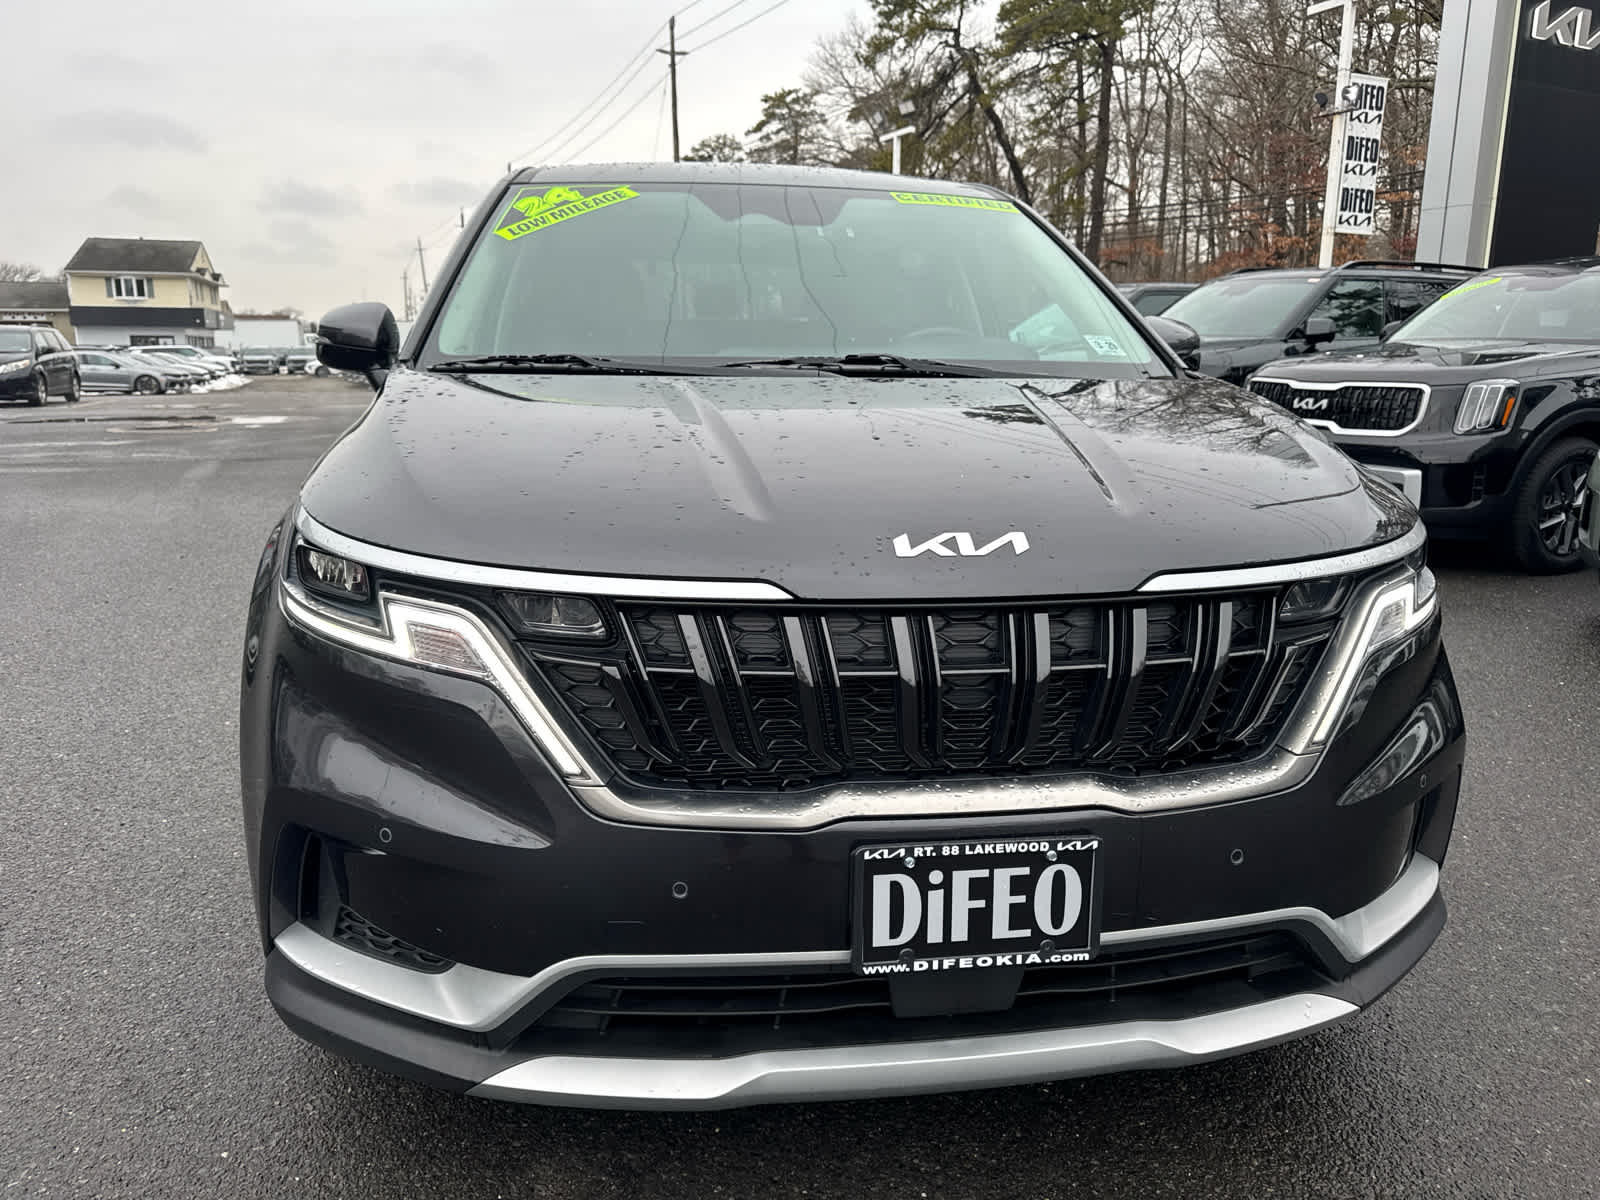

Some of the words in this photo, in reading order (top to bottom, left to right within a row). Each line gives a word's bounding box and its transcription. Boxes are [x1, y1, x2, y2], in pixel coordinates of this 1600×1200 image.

[1532, 0, 1600, 50] KI
[1349, 111, 1382, 124] KIA
[1346, 135, 1379, 163] DiFEO
[1344, 164, 1377, 177] KIA
[895, 193, 1012, 210] CERTIFIED
[1340, 187, 1374, 214] DiFEO
[507, 214, 549, 236] LOW
[549, 190, 627, 220] MILEAGE
[1338, 214, 1371, 227] KIA
[1293, 397, 1330, 410] KIA
[893, 531, 1030, 558] KIA
[863, 847, 906, 861] KIA
[914, 846, 937, 857] RT.
[942, 845, 960, 856] 88
[965, 842, 1050, 855] LAKEWOOD
[1056, 840, 1099, 851] KIA
[872, 863, 1083, 948] DiFEO
[862, 952, 1090, 976] www.DIFEOKIA.com
